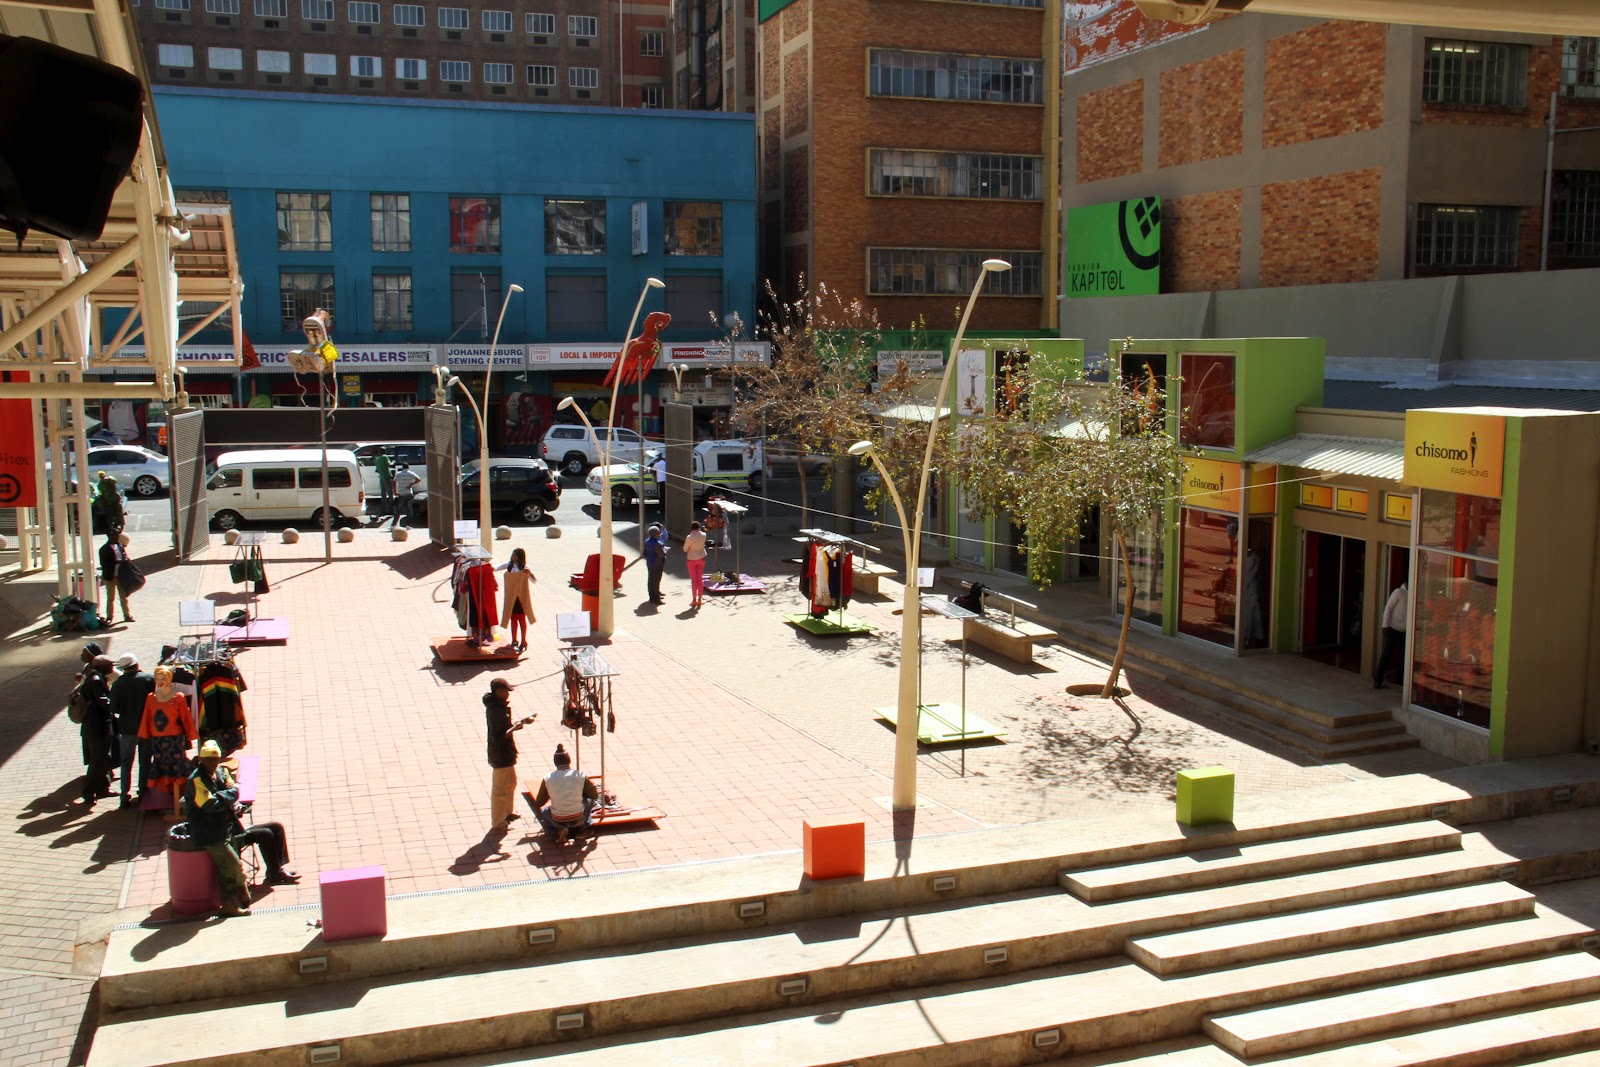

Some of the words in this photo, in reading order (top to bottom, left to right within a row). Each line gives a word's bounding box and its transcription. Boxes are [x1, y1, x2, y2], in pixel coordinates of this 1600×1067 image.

[1068, 262, 1100, 272] FASHION
[1071, 270, 1125, 292] KAPITOL
[335, 352, 406, 362] LESALERS
[1415, 440, 1468, 461] chisomo
[1450, 467, 1489, 478] FASHIONS
[1189, 477, 1220, 491] chisomo
